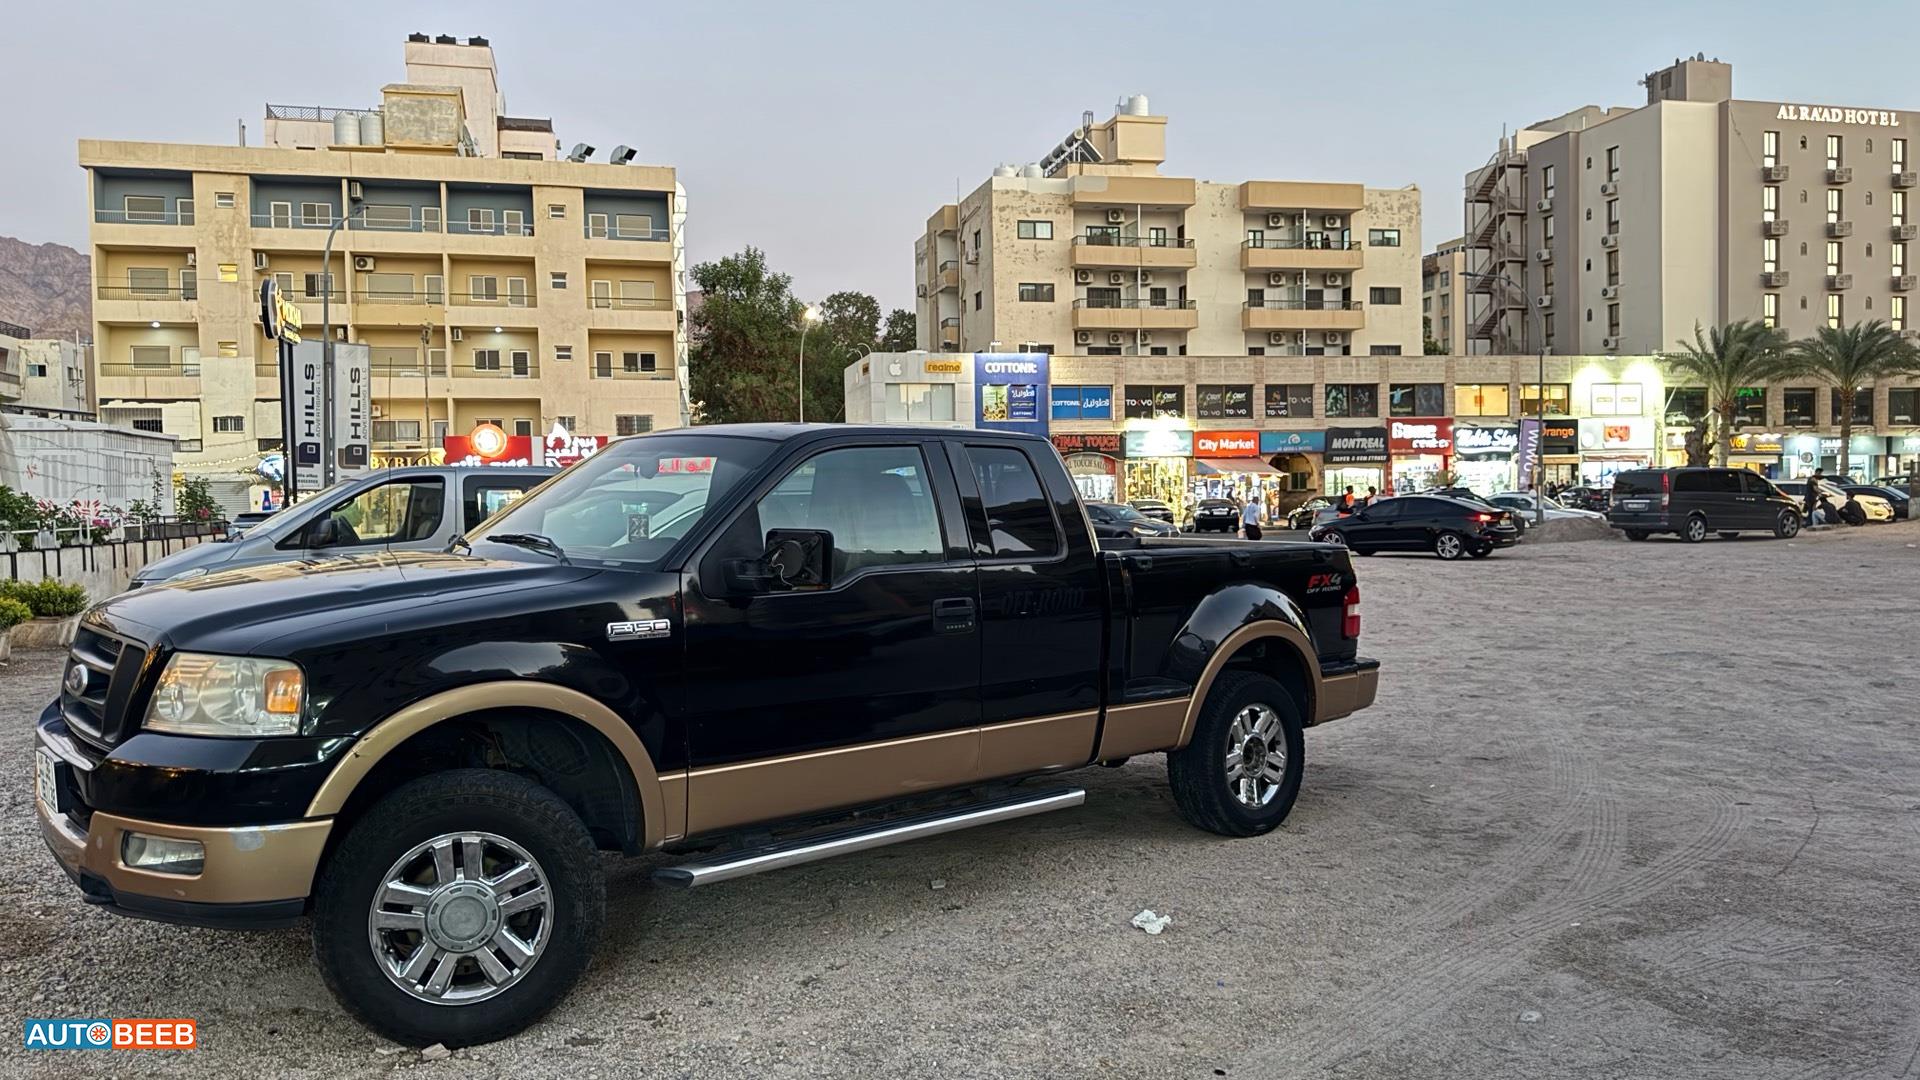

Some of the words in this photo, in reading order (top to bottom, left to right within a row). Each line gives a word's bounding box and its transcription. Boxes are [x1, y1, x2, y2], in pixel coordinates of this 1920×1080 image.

[1777, 105, 1798, 120] AL
[1799, 106, 1843, 123] RA'AD
[1844, 110, 1899, 127] HOTEL
[927, 362, 960, 373] realme
[305, 363, 315, 437] HILLS
[350, 367, 361, 440] HILLS
[1085, 434, 1119, 448] TOUCH
[1199, 439, 1218, 452] City
[1219, 438, 1255, 450] Market
[1332, 438, 1385, 450] MONTREAL
[371, 455, 441, 469] BYBLOS
[1307, 573, 1341, 588] FX4
